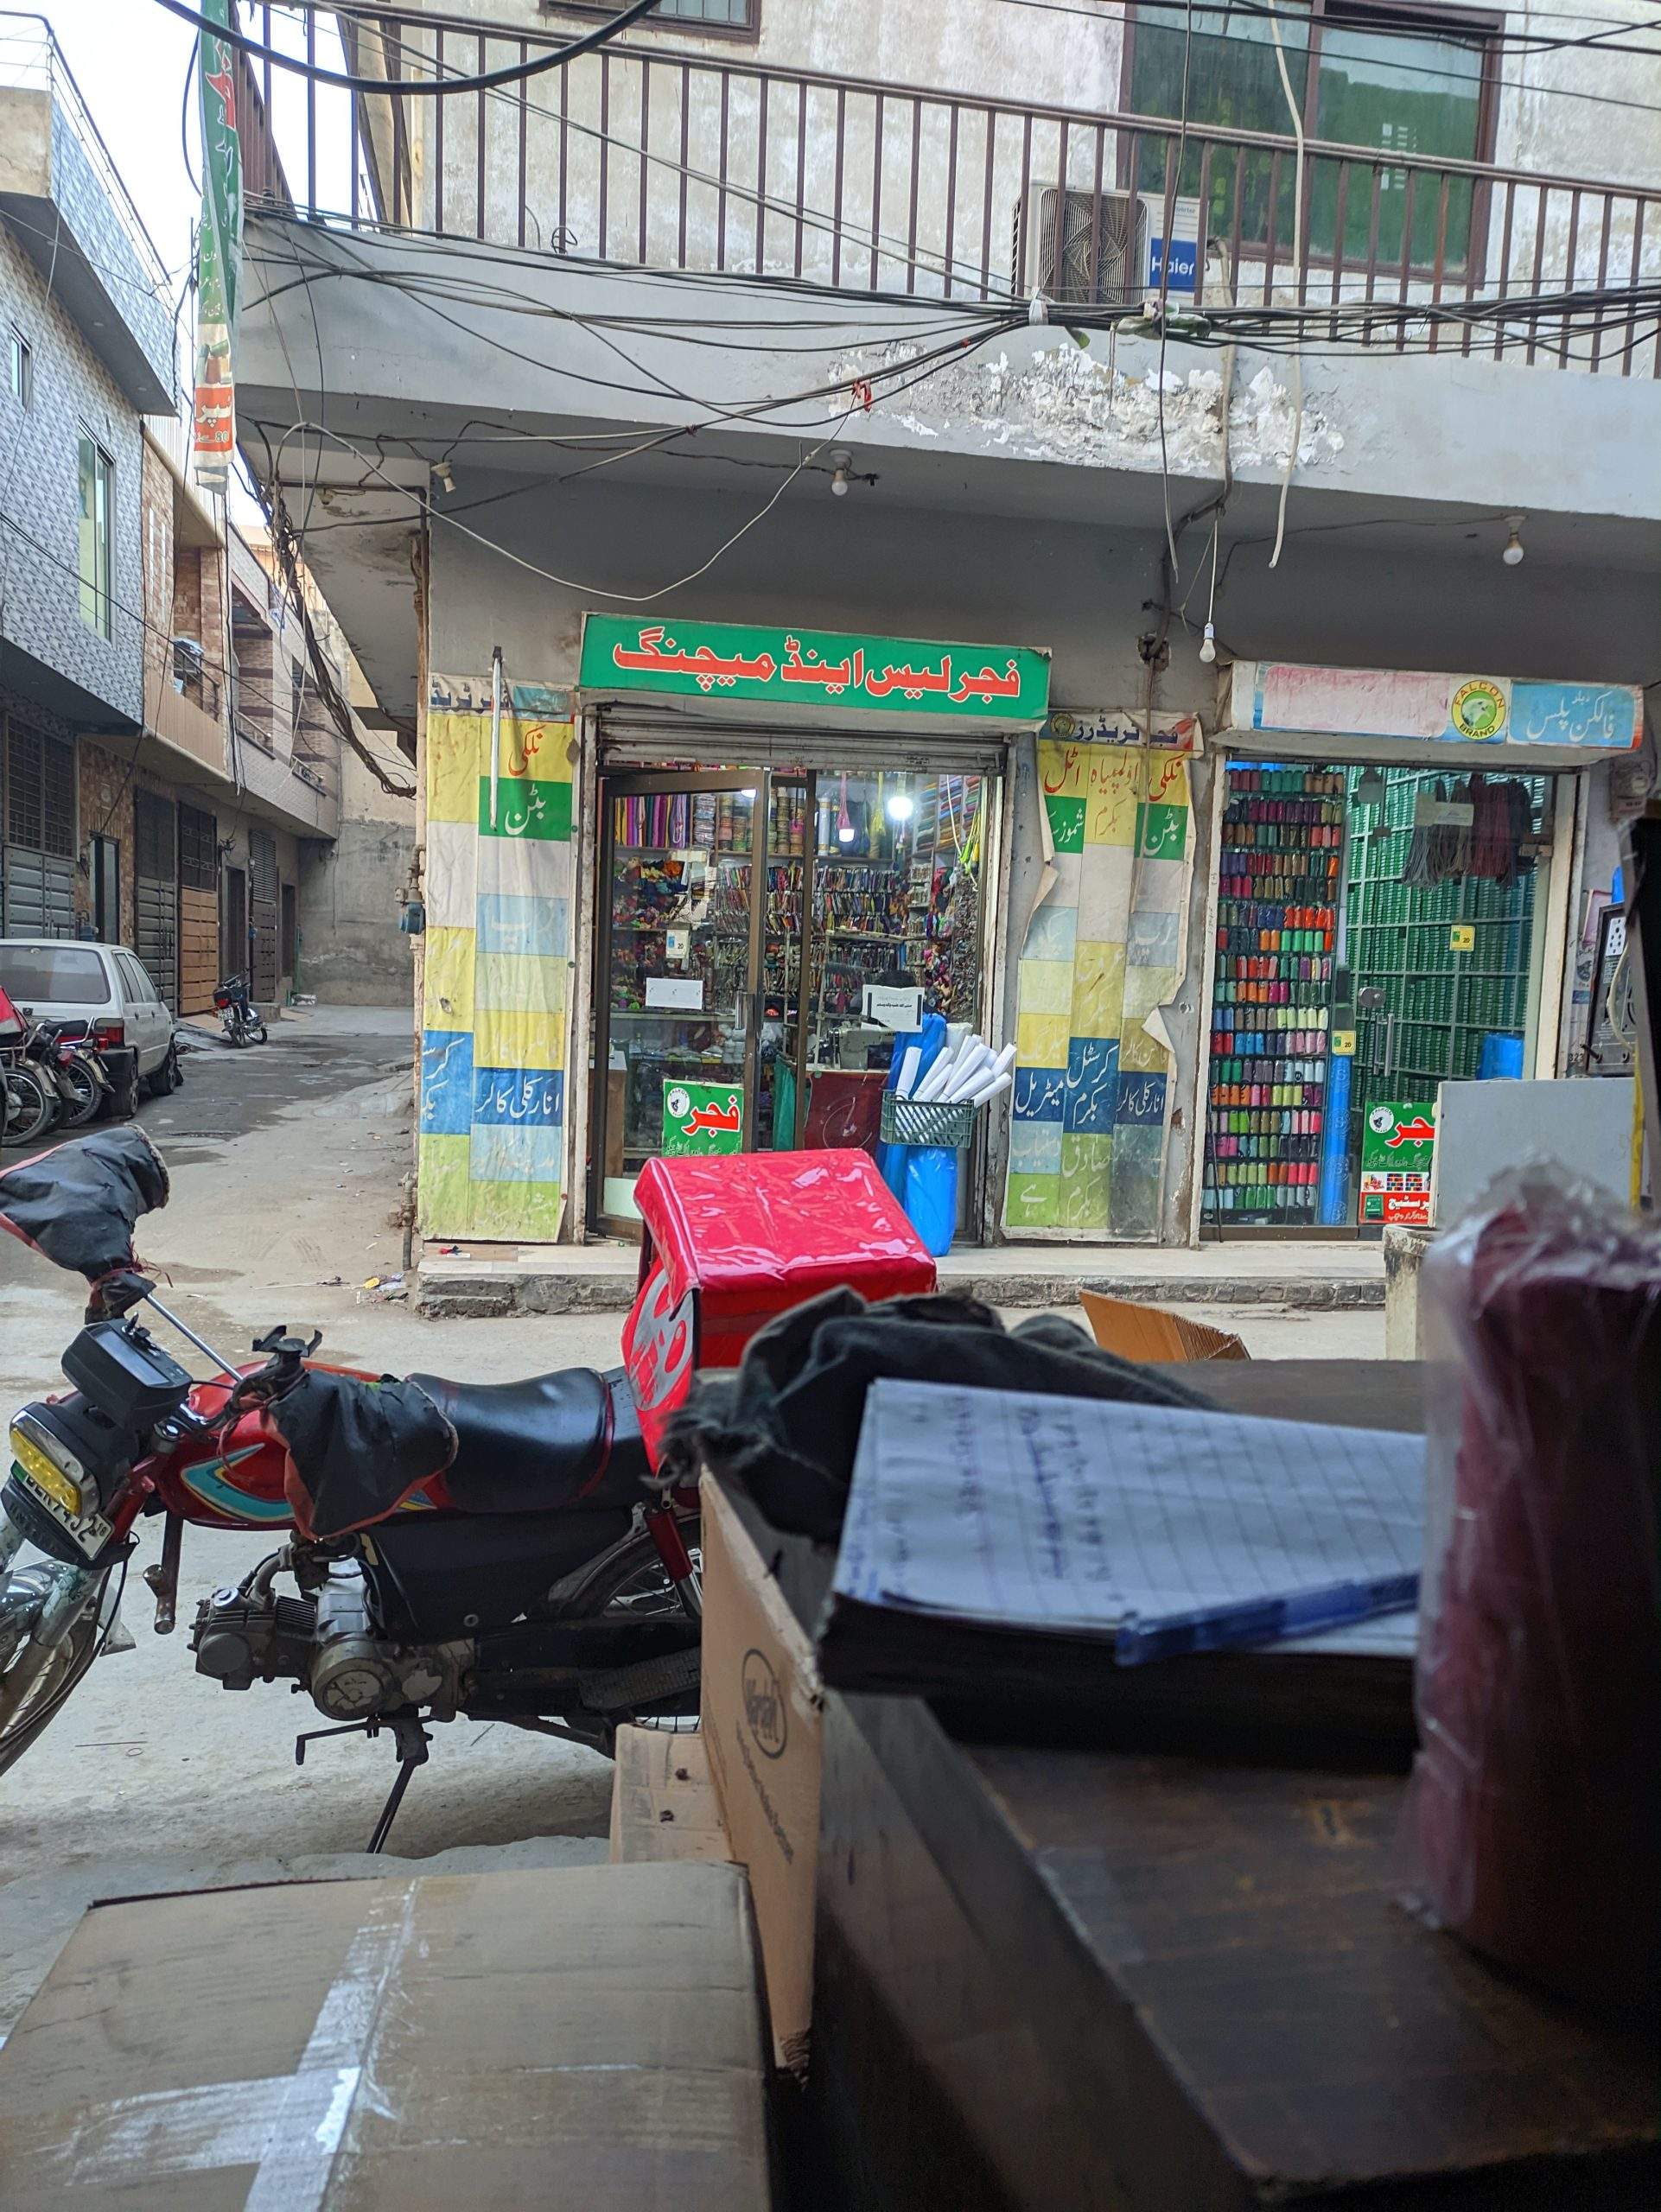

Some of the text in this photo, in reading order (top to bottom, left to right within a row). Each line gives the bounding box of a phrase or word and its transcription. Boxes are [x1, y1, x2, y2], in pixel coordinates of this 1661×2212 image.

[1151, 256, 1194, 276] Haier
[613, 626, 1021, 704] فجر لیس اینڈ میچنگ
[1454, 681, 1505, 709] FALCON
[1569, 690, 1614, 743] فالکن
[1460, 722, 1495, 739] BRAND
[1527, 696, 1571, 741] پلس
[505, 783, 546, 836] بٹن
[1142, 807, 1180, 856] بٹن
[1066, 1041, 1119, 1088] کرسٹل
[475, 1075, 560, 1119] انارکلی کالر
[681, 1094, 741, 1139] فجر
[1015, 1071, 1065, 1117] میٹریل
[1072, 1083, 1107, 1129] بکرم
[1117, 1081, 1165, 1116] انارکلی کالر
[1384, 1116, 1436, 1148] جر
